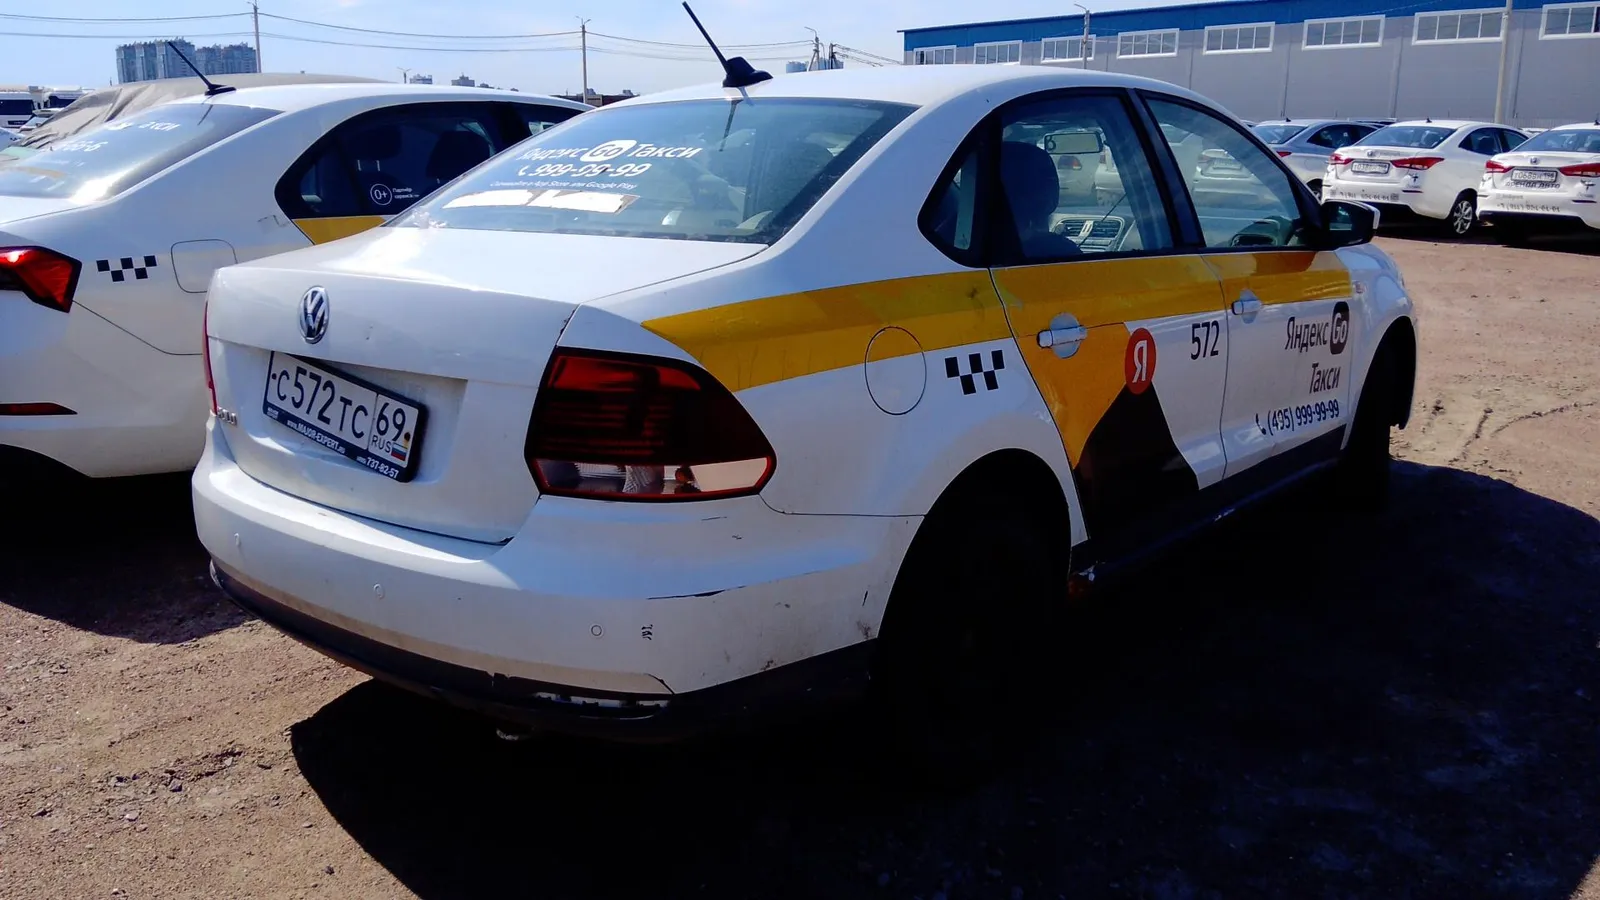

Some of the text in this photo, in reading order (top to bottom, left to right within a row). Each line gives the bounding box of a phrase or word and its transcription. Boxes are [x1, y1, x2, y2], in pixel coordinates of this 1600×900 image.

[627, 143, 703, 158] Такси
[374, 189, 388, 200] 0+
[1190, 320, 1220, 360] 572
[1285, 316, 1329, 353] Яндекс
[1132, 340, 1148, 383] Я
[1309, 362, 1341, 394] Такси
[276, 366, 369, 439] С572ТС
[1267, 399, 1340, 436] (495) 999-99-99
[376, 402, 406, 442] 69
[371, 434, 392, 453] RUS
